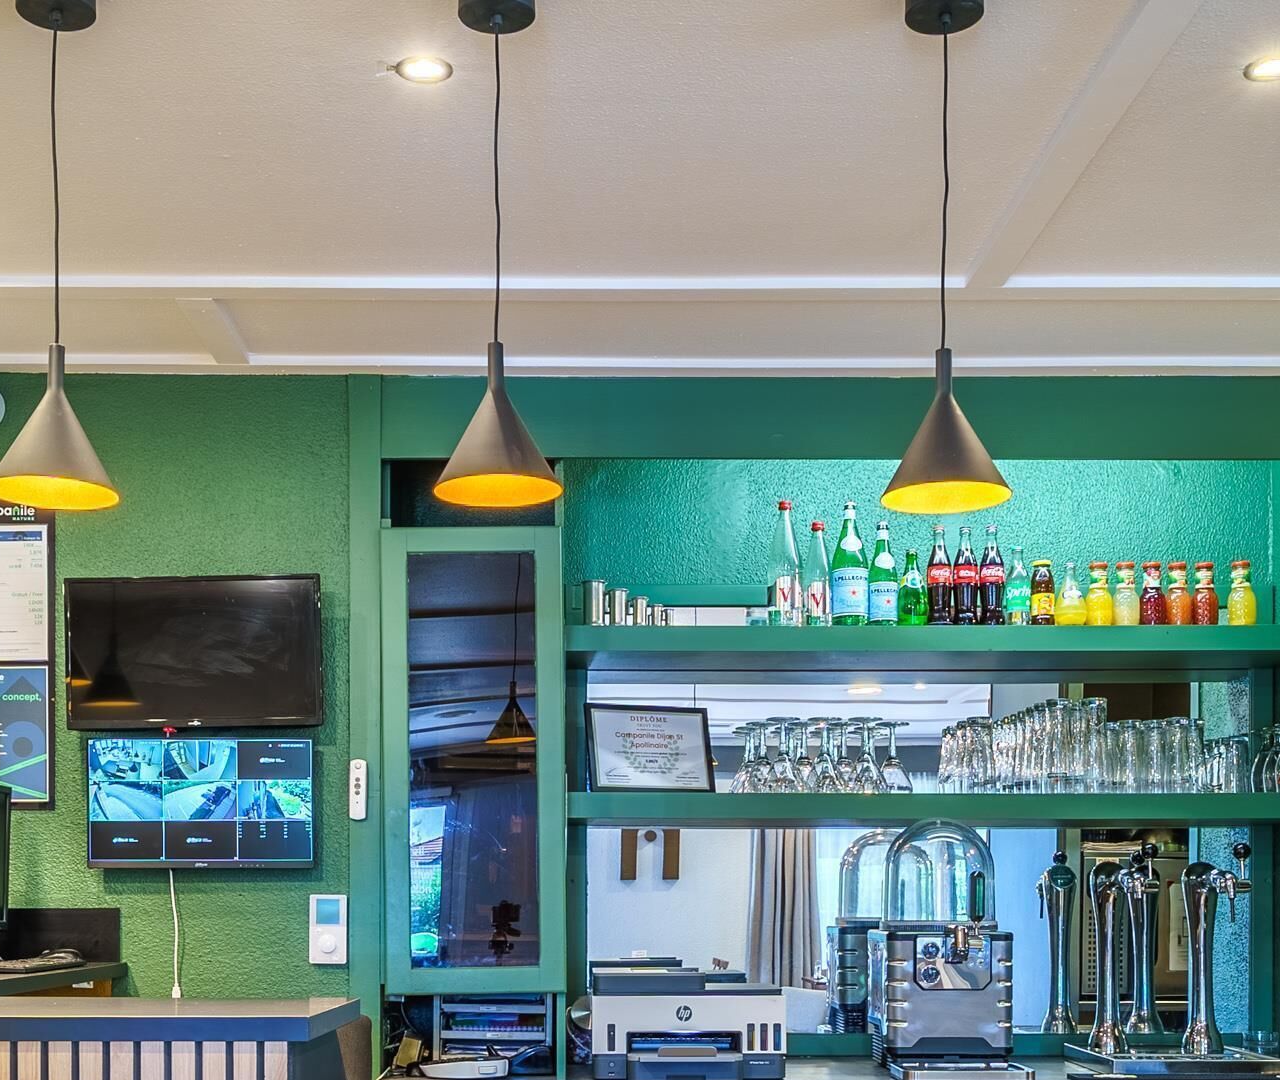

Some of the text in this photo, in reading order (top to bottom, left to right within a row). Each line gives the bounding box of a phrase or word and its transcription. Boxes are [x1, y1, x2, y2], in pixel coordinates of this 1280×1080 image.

[2, 693, 42, 703] concept,
[630, 715, 668, 723] DIPLÔME
[615, 731, 656, 740] Campanile
[656, 733, 675, 741] Dijon
[630, 741, 669, 750] Apollinaire
[676, 1005, 693, 1022] hp
